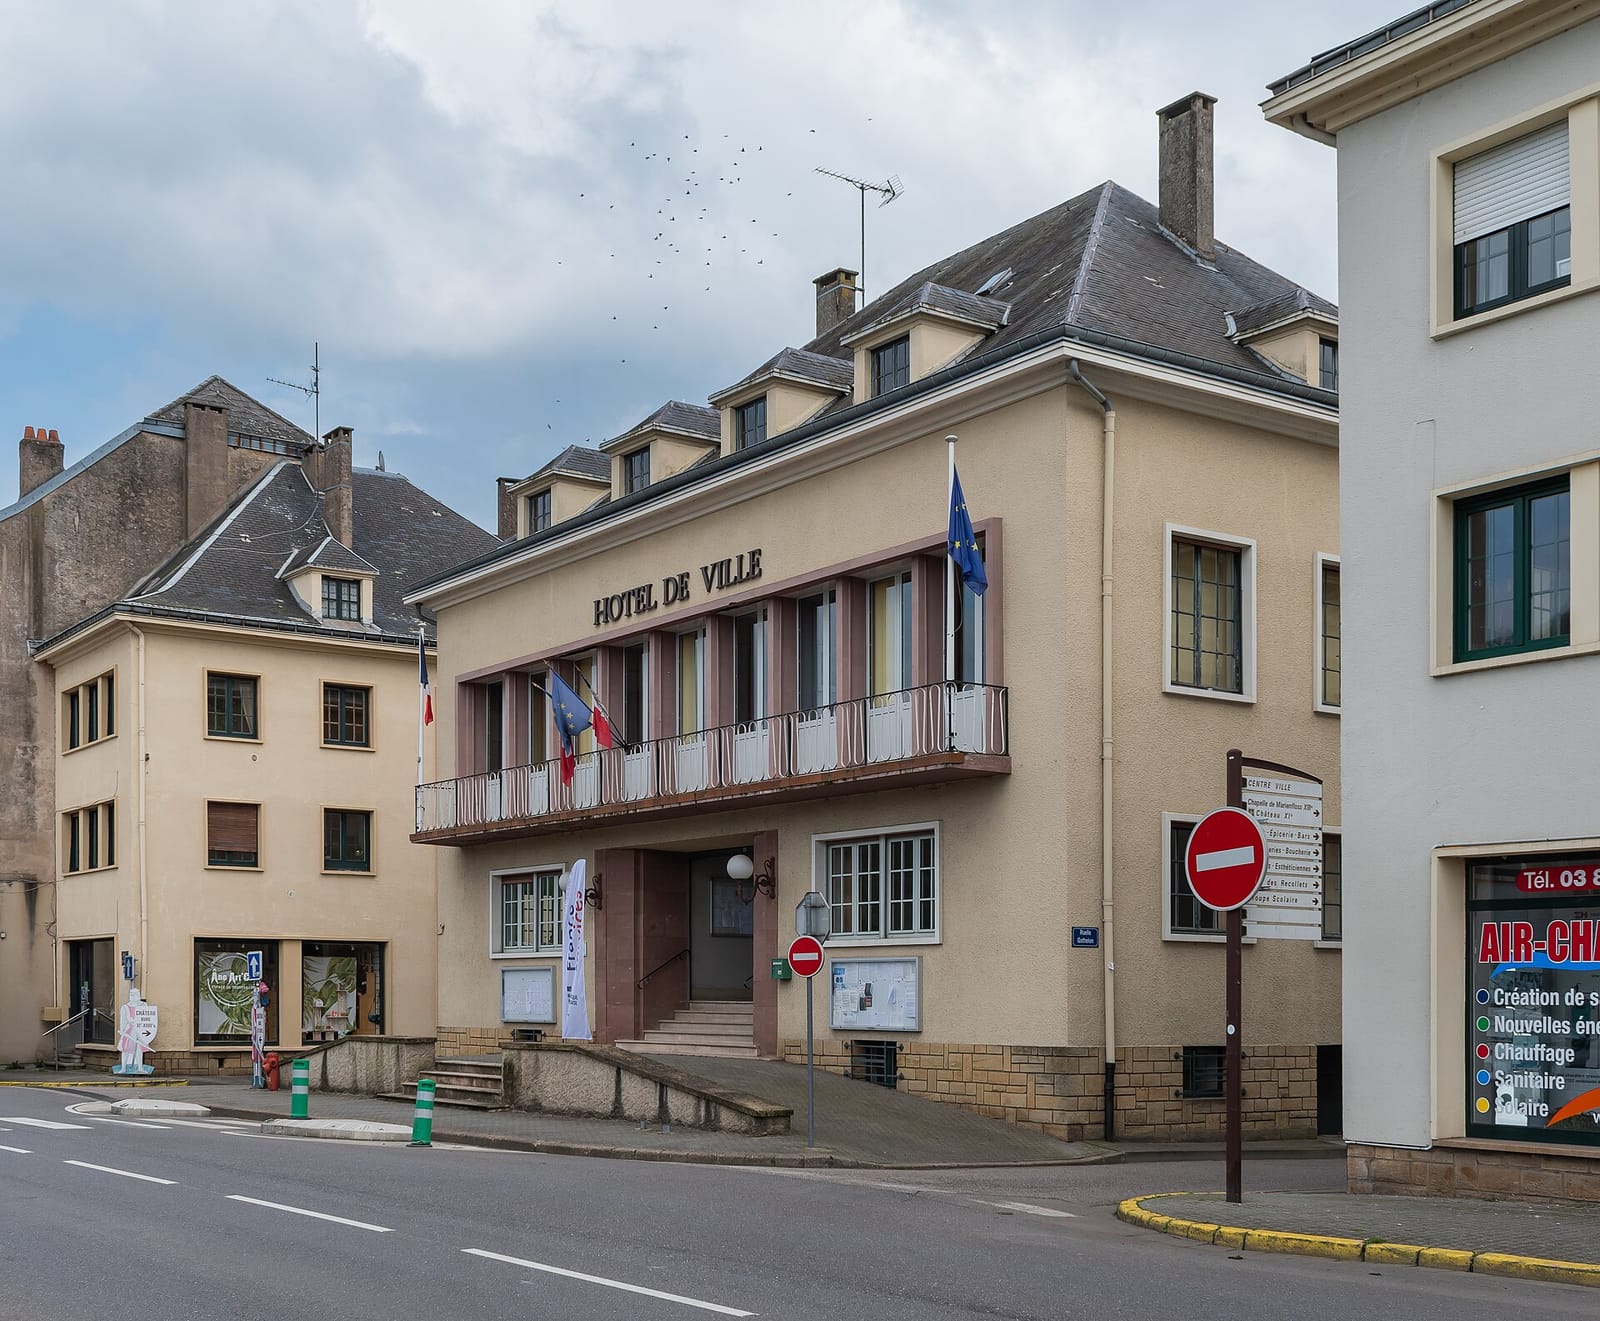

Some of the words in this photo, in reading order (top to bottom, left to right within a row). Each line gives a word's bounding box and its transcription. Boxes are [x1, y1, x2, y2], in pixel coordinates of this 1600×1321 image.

[593, 583, 658, 626] HOTEL
[662, 571, 691, 606] DE
[700, 549, 763, 593] VILLE
[1248, 779, 1271, 789] CENTRE
[1275, 783, 1292, 792] VILLE
[1256, 809, 1281, 818] Château
[1267, 879, 1277, 887] des
[1523, 870, 1555, 889] Tél.
[1560, 869, 1587, 888] 03
[1272, 895, 1298, 904] Scolaire
[1494, 987, 1560, 1006] Création
[1564, 988, 1585, 1006] de
[1494, 1015, 1571, 1034] Nouvelles
[1494, 1042, 1575, 1066] Chauffage
[1494, 1069, 1566, 1090] Sanitaire
[1494, 1096, 1549, 1117] Solaire
